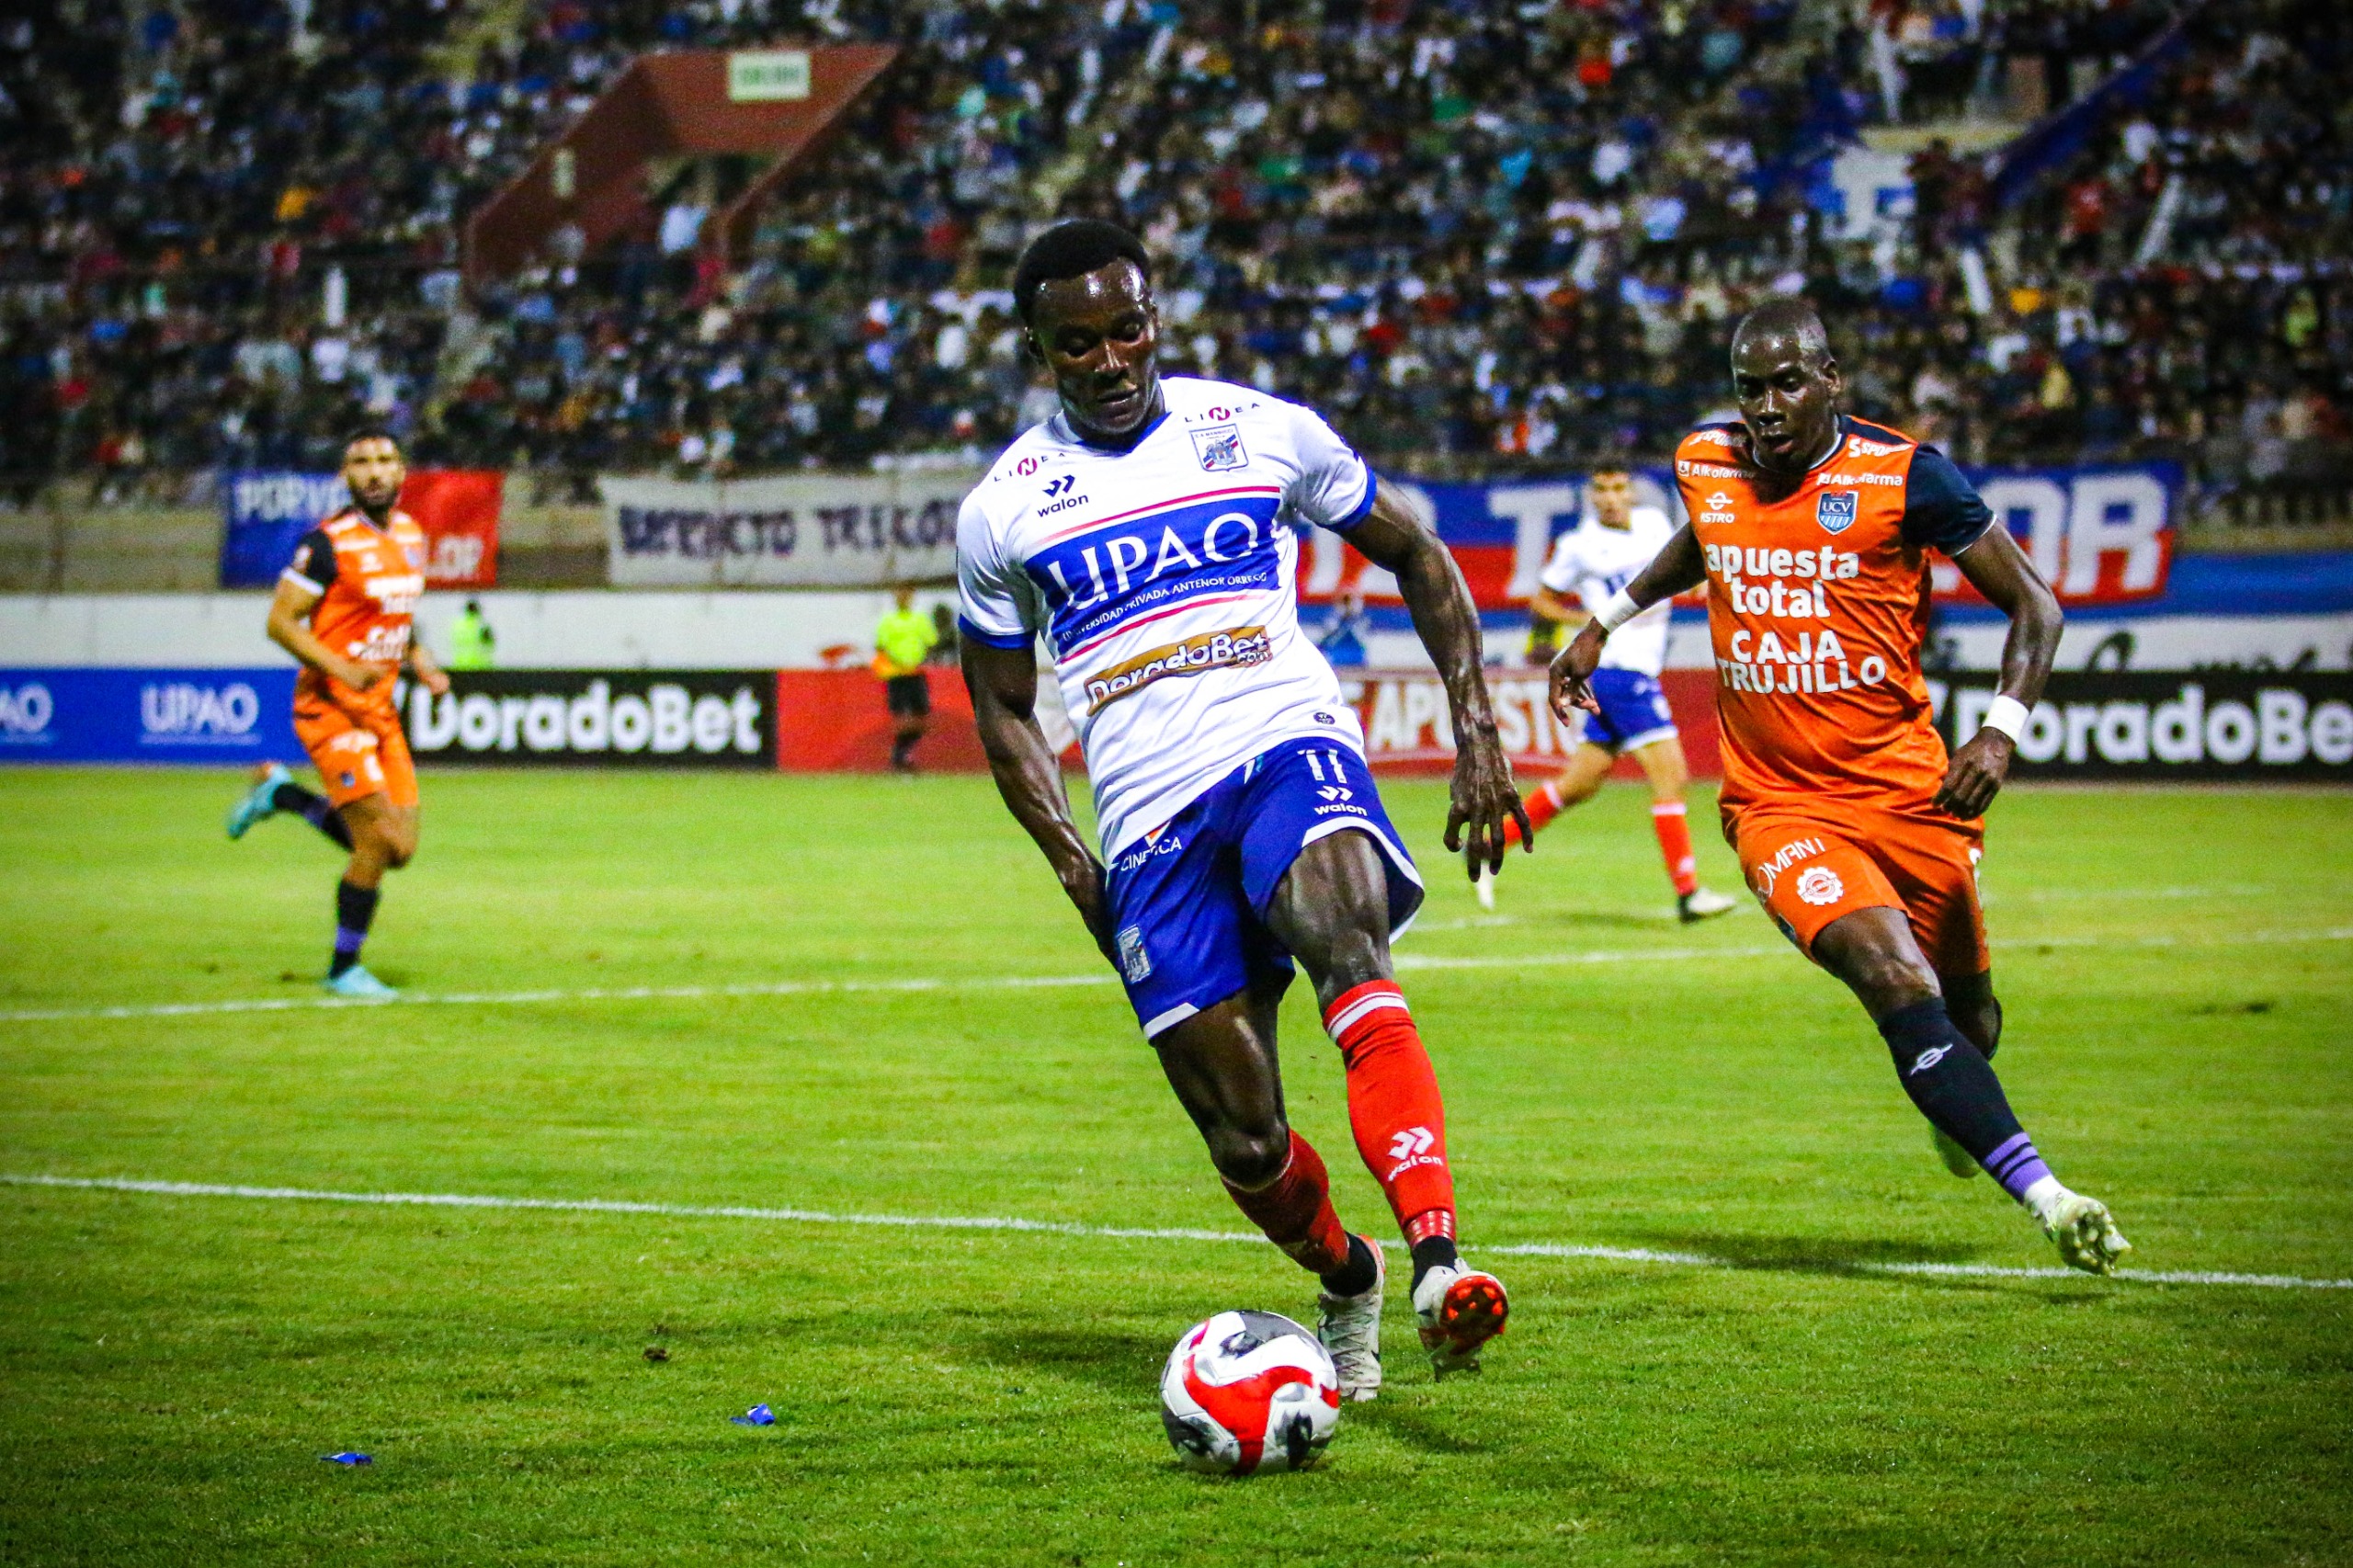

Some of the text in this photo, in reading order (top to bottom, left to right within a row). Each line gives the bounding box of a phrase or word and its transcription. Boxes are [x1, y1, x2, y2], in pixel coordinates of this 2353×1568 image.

[1037, 494, 1089, 517] walon
[1823, 502, 1851, 513] UCV
[1048, 512, 1259, 610] UPAO
[1705, 544, 1860, 583] apuesta
[1062, 607, 1124, 642] UNVERSIDAD
[1172, 576, 1225, 595] ANTENOR
[1731, 577, 1831, 618] total
[1731, 630, 1847, 665] CAJA
[1716, 655, 1887, 695] TRUJILLO
[410, 679, 763, 753] DoradoBet
[1955, 681, 2353, 766] oradoBe
[1313, 802, 1369, 817] walon
